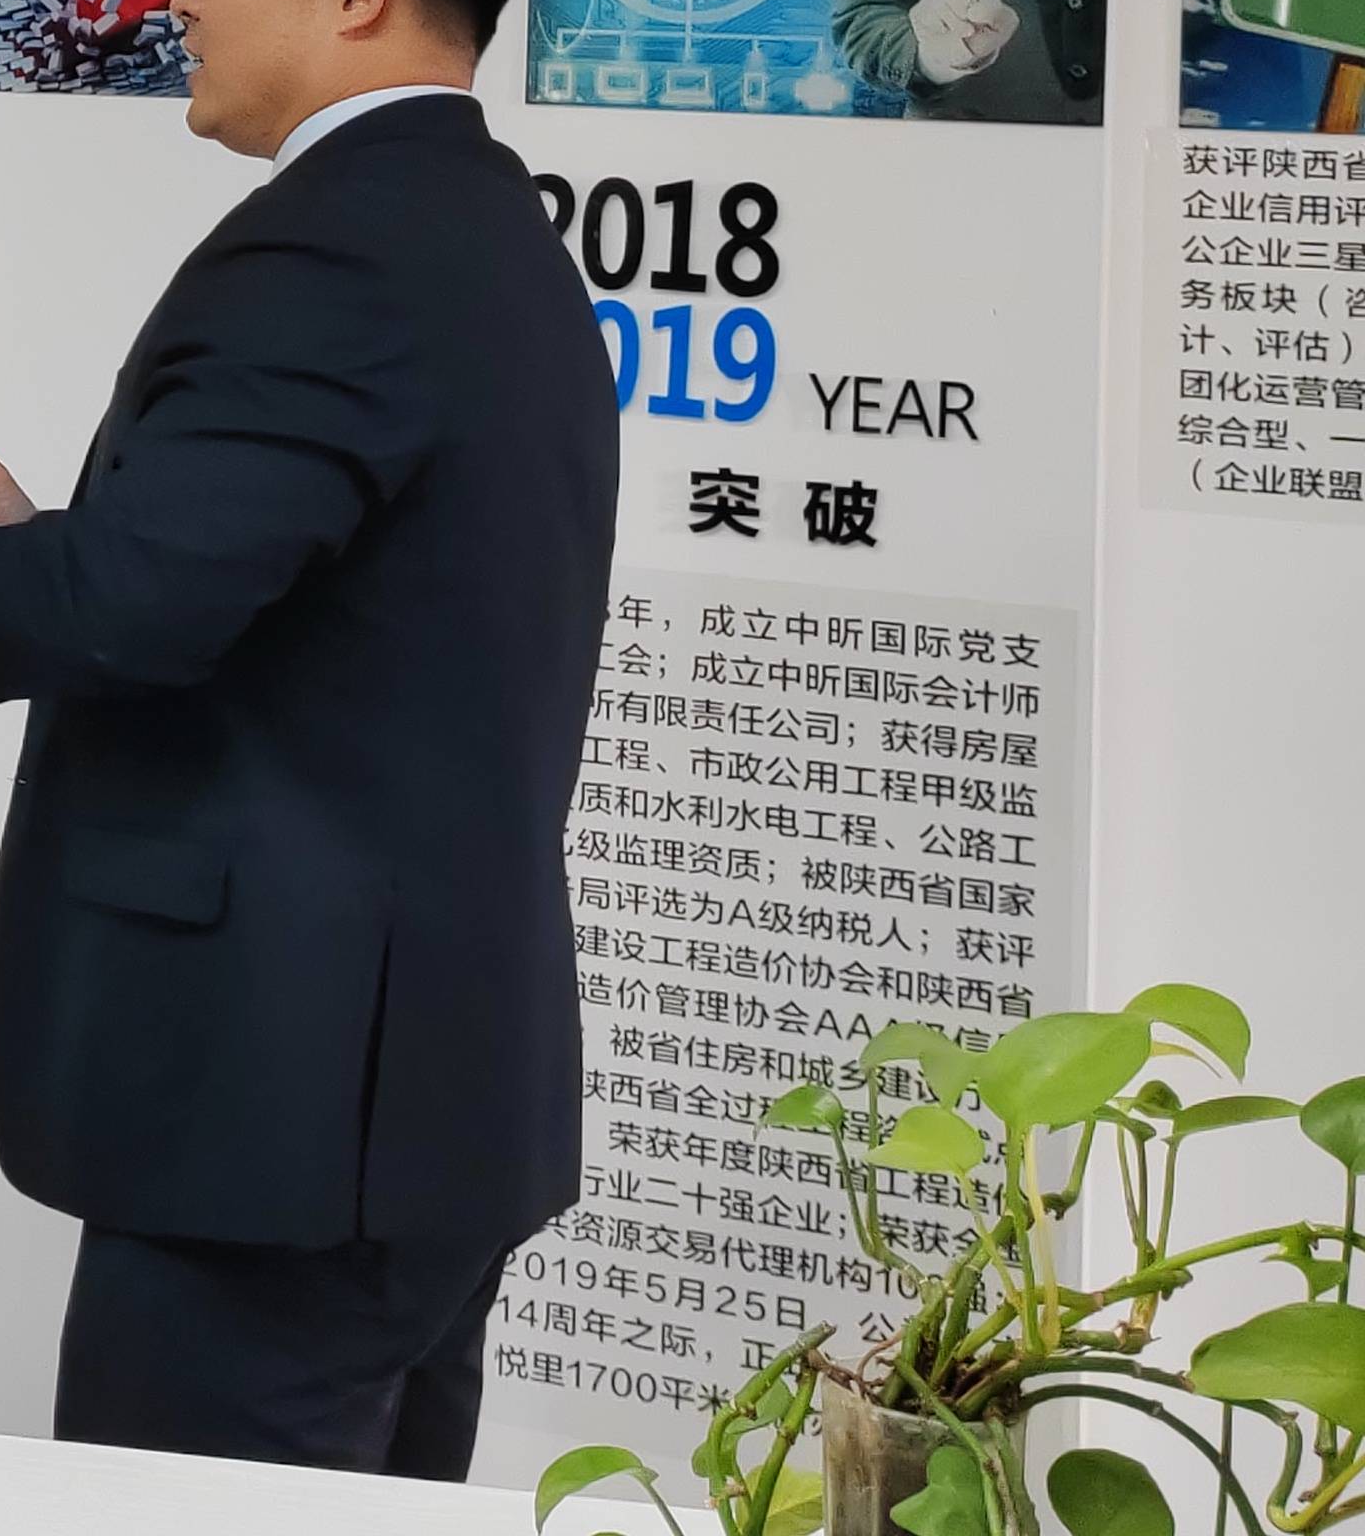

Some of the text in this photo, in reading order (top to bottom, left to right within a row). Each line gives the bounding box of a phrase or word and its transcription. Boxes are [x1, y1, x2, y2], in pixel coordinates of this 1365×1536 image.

[808, 372, 979, 442] YEAR
[570, 782, 1037, 867] 质和水利水电工程、公路工
[565, 828, 1035, 916] 级监理资质；被陕西省国家
[567, 876, 1034, 967] 局评选为A级纳税人；获评
[575, 925, 1033, 1019] 建设工程造价协会和陕西省
